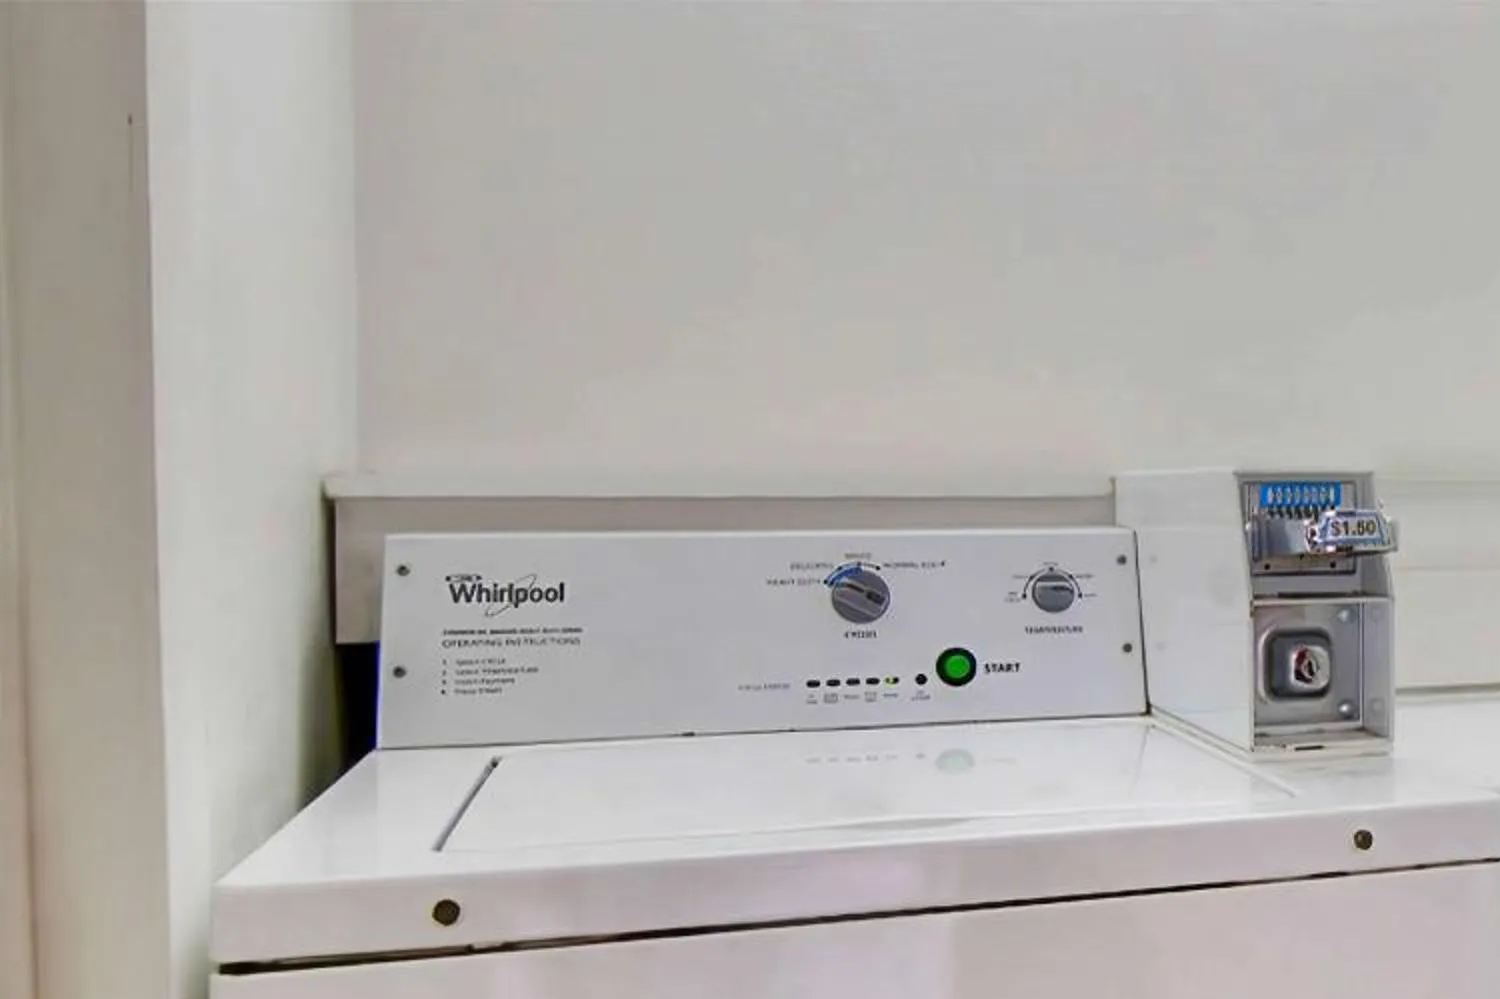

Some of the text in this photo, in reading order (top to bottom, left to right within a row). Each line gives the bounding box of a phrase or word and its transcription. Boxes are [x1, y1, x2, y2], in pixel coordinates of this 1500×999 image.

[1331, 520, 1377, 536] $1.50
[449, 581, 565, 608] Whirlpool
[984, 662, 1021, 674] START
